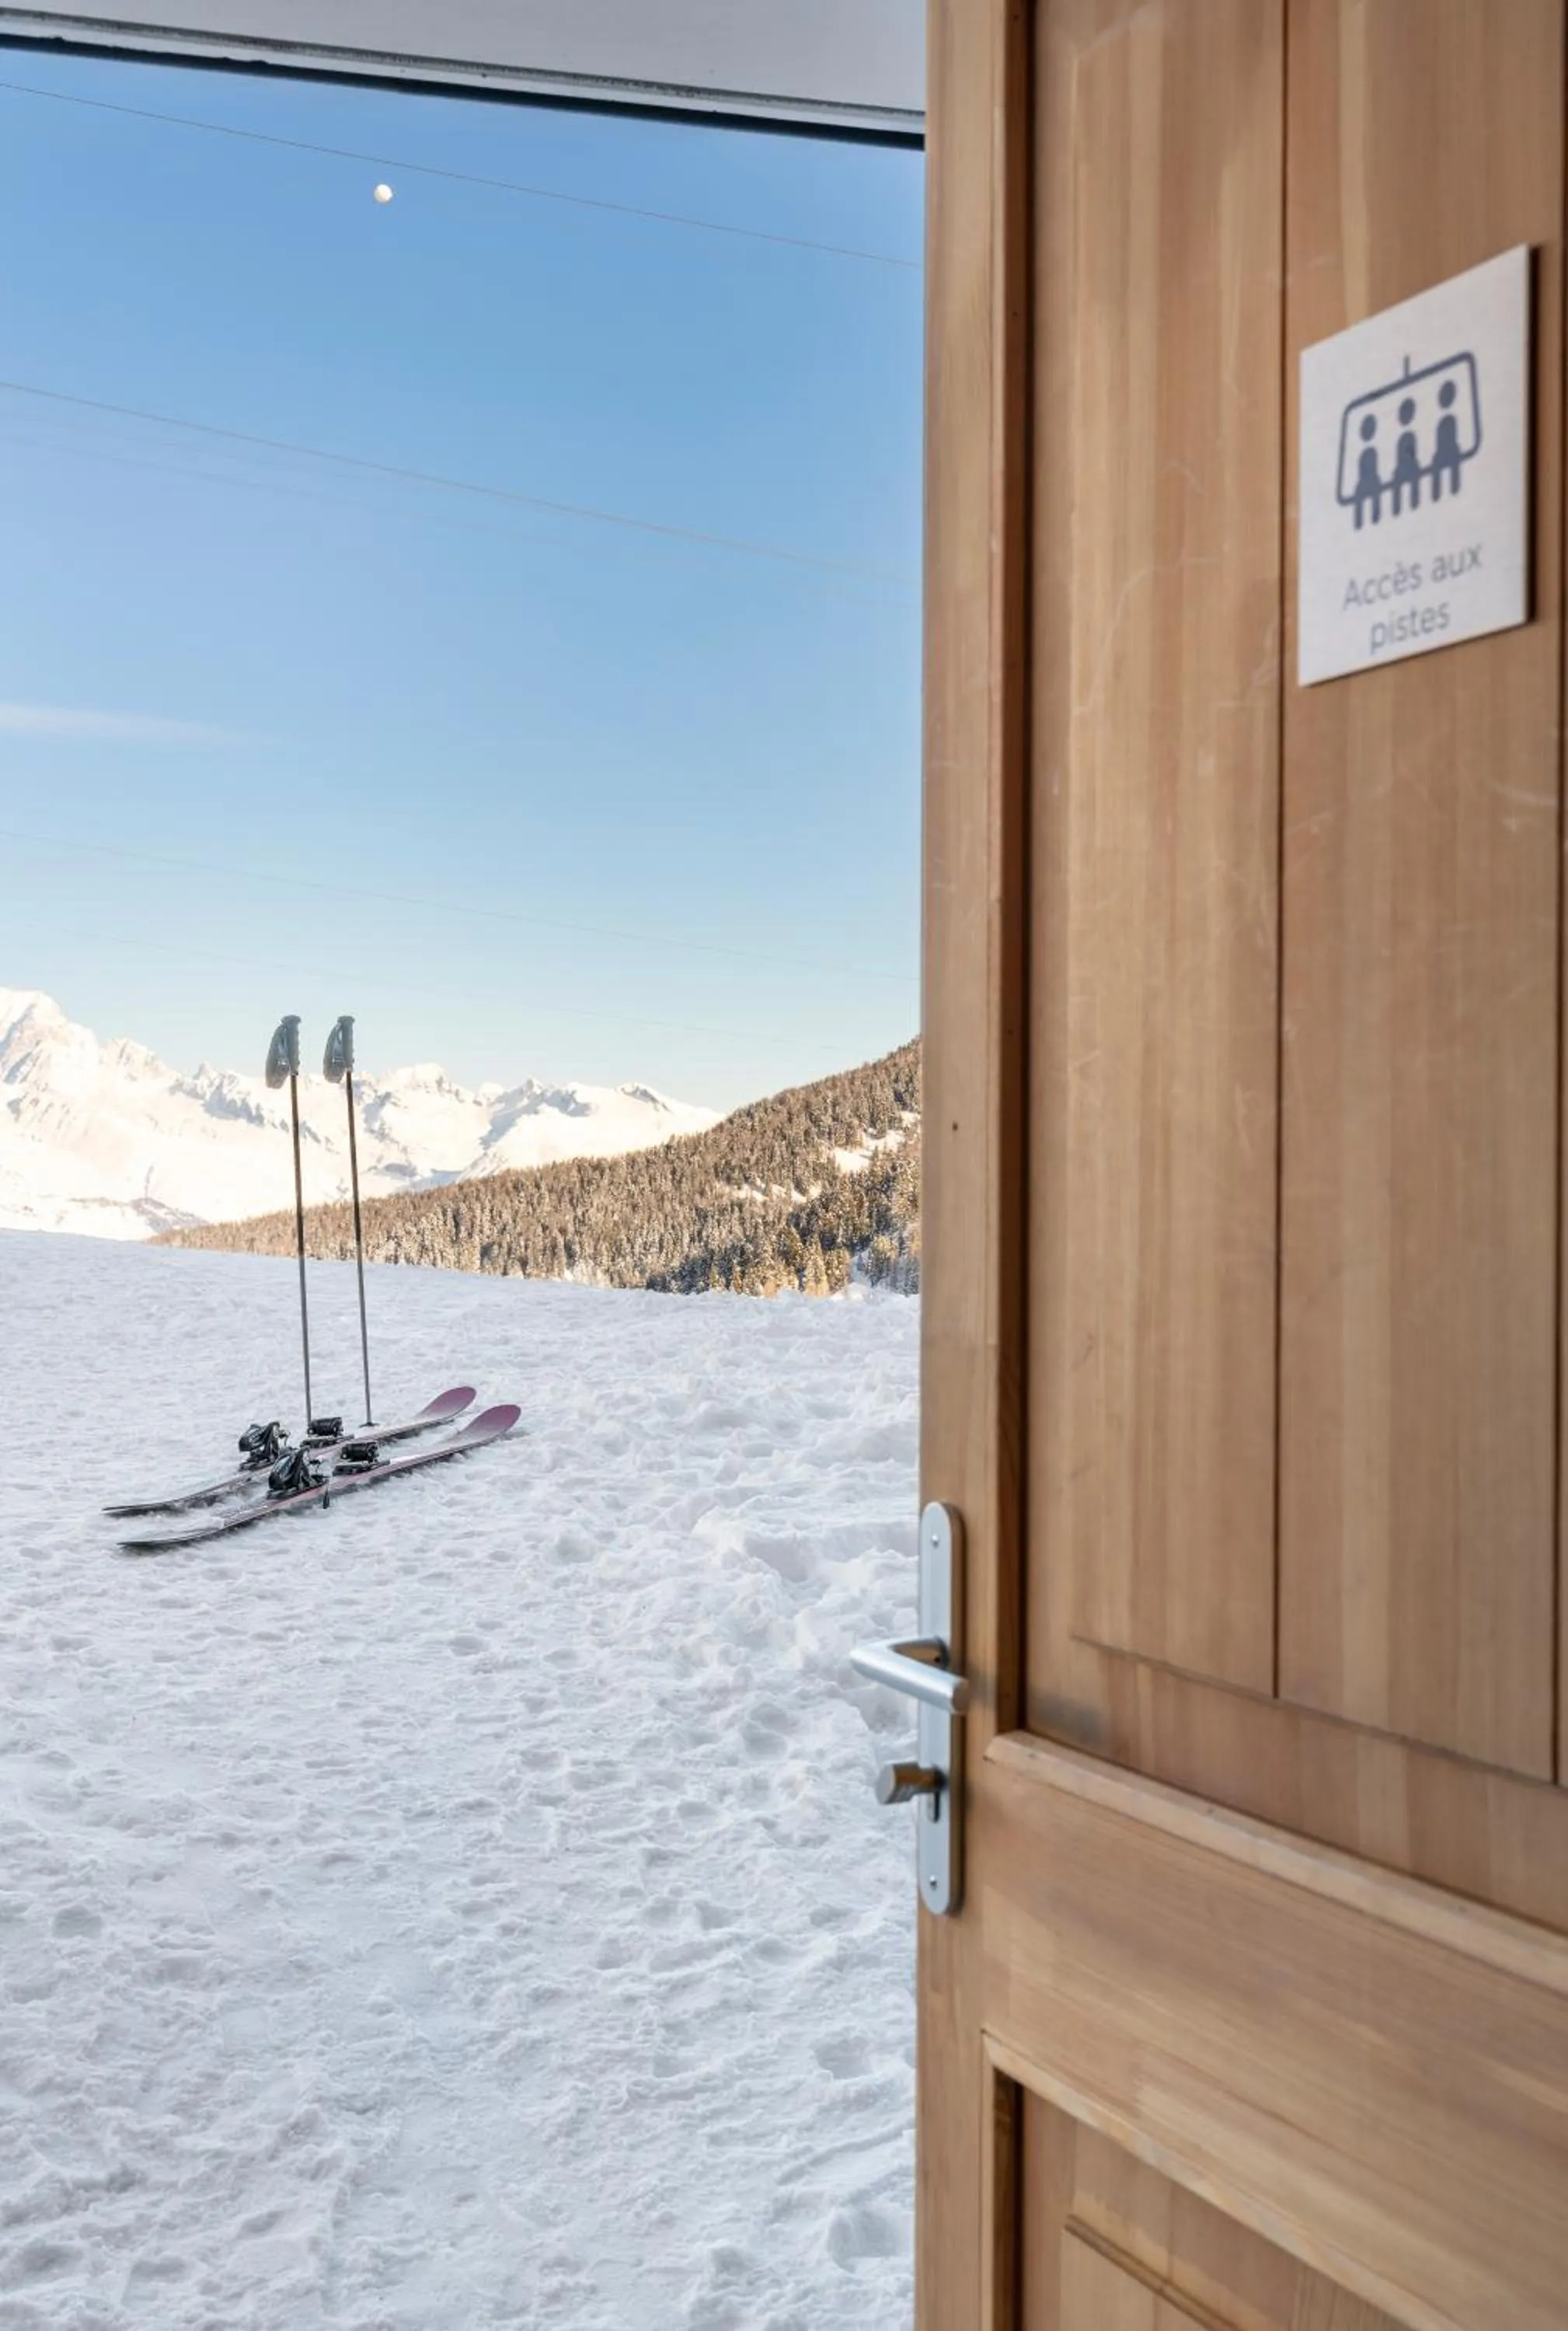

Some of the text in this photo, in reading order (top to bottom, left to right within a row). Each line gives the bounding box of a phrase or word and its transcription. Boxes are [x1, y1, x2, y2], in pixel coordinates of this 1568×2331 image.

[1343, 544, 1483, 610] Accès aux
[1369, 602, 1451, 655] pistes
